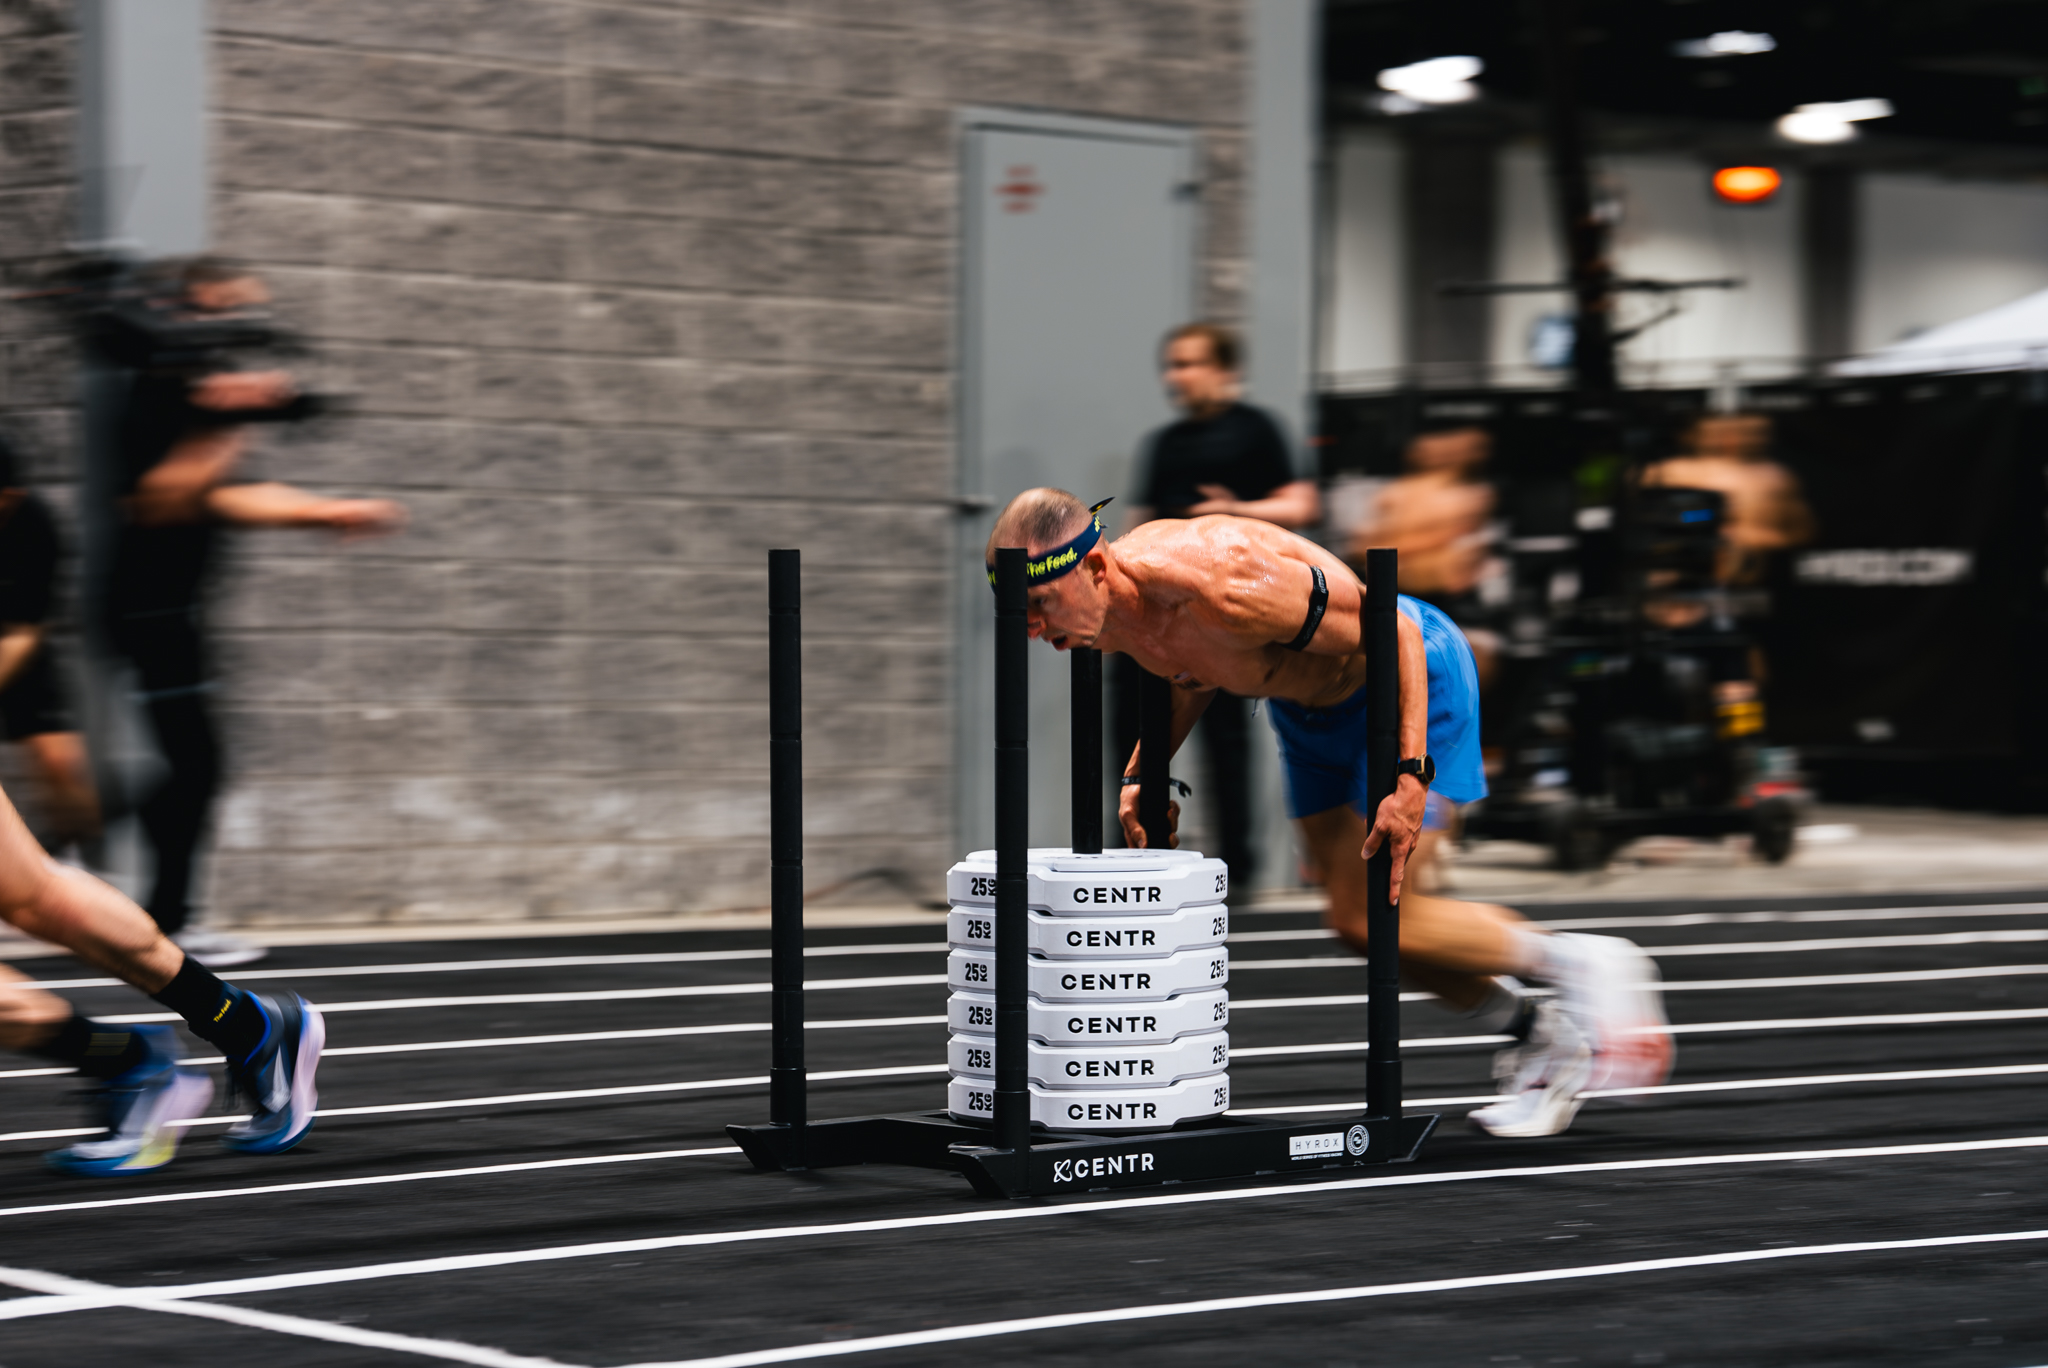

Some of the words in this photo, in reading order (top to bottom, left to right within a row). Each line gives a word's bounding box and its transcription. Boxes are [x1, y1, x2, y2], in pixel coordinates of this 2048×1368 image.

[1072, 886, 1162, 904] CENTR
[1066, 929, 1156, 947] CENTR
[1060, 973, 1151, 991] CENTR
[1067, 1016, 1157, 1034] CENTR
[1065, 1059, 1155, 1077] CENTR
[1067, 1102, 1157, 1120] CENTR
[1295, 1137, 1340, 1151] HYROX
[1074, 1152, 1155, 1178] CENTR
